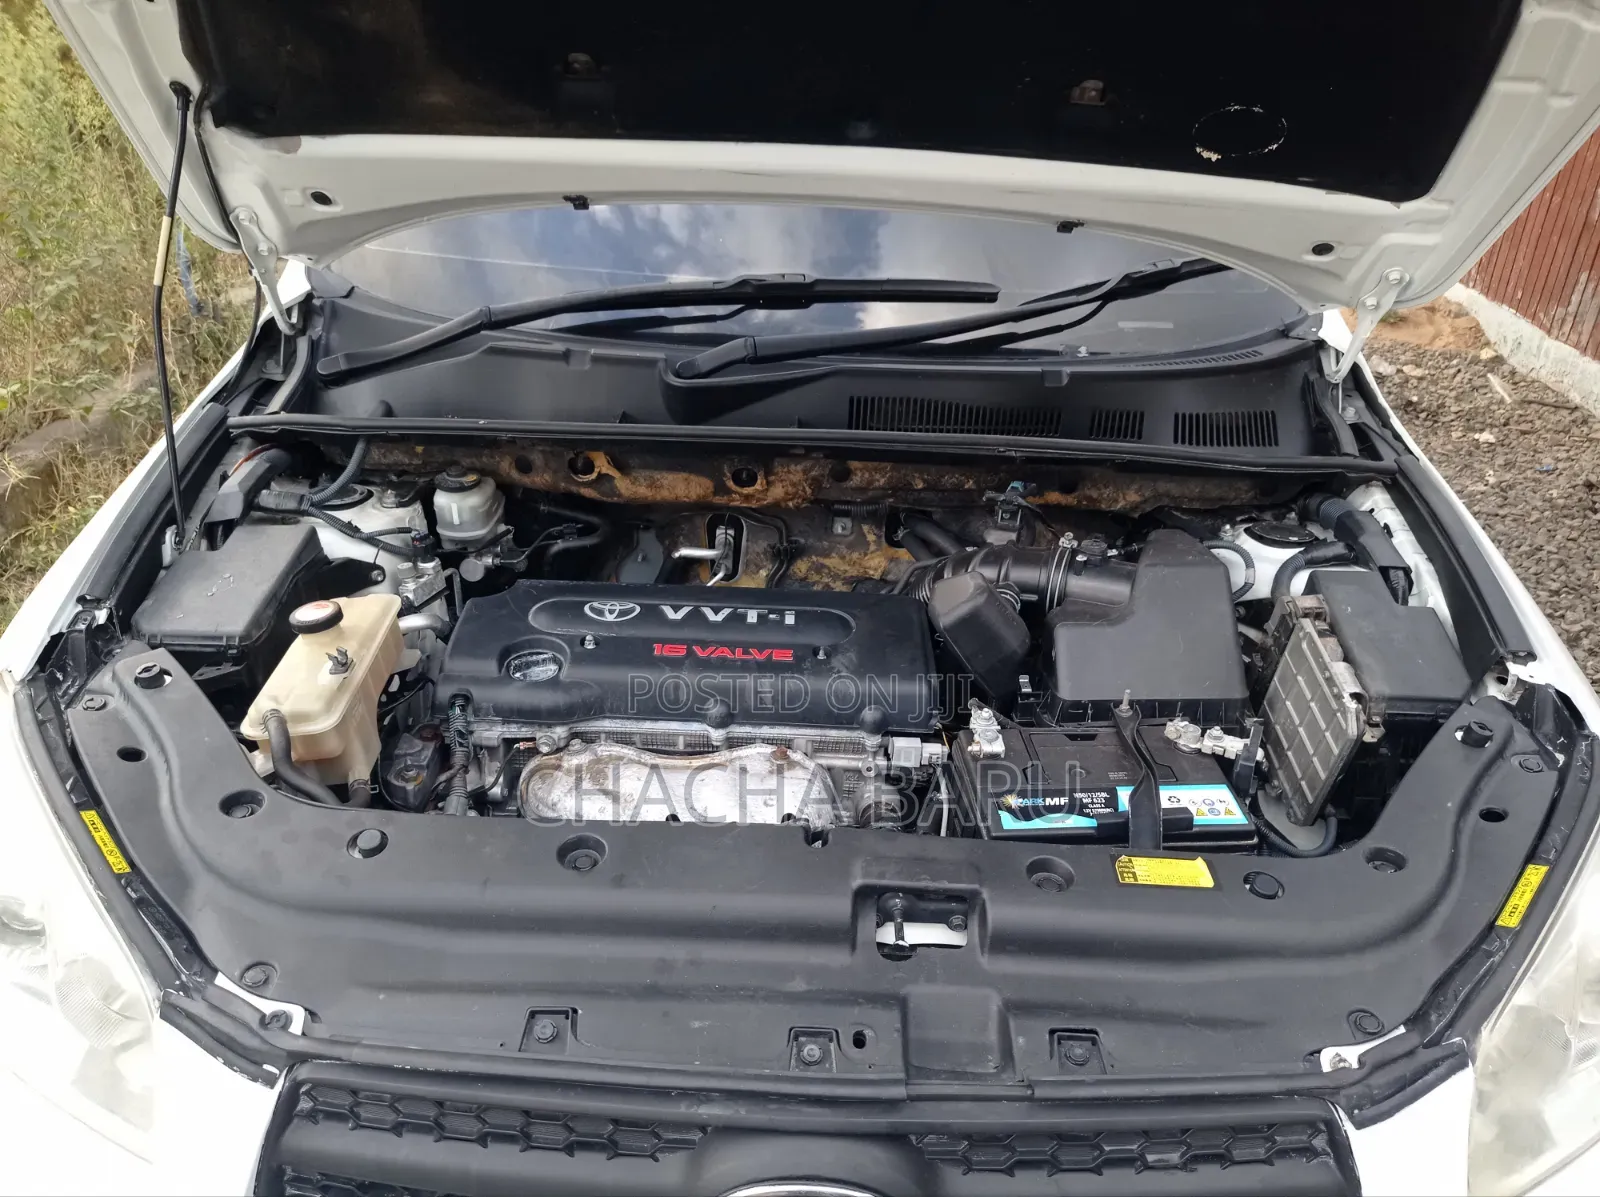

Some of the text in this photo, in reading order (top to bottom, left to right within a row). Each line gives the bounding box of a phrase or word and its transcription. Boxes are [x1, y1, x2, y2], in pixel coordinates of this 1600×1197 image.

[660, 604, 796, 625] VVT-i
[653, 643, 794, 661] 16 VALVE
